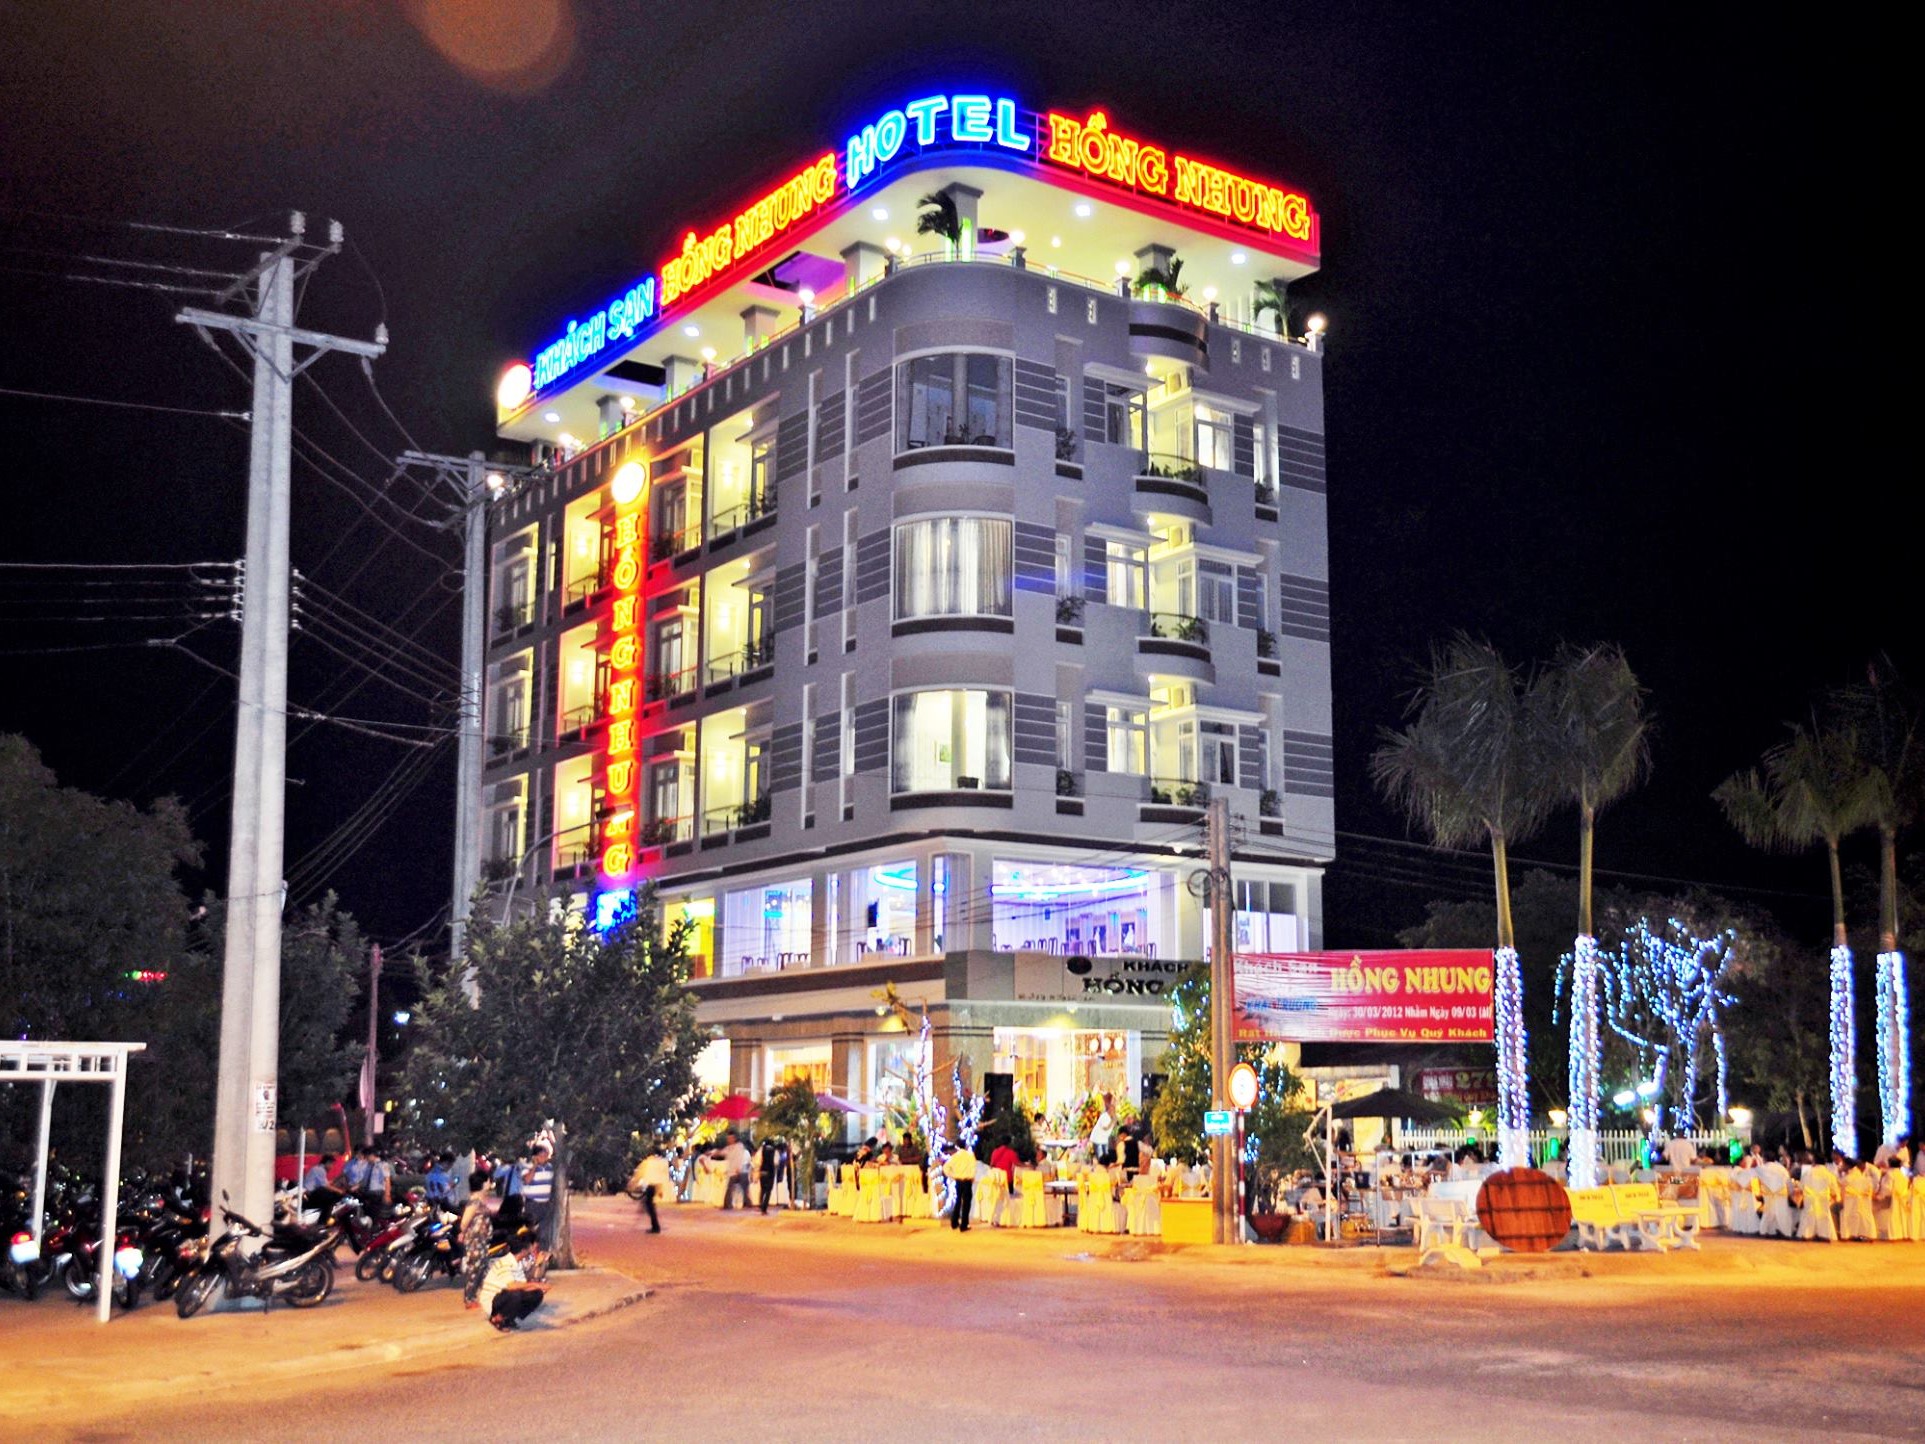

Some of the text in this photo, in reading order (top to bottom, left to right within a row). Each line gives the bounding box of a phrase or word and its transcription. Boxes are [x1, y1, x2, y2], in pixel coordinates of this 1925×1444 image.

[846, 94, 1031, 189] HOTEL
[1049, 112, 1311, 240] HỒNG NHUNG
[660, 153, 838, 306] HỒNG NHUNG
[534, 276, 655, 390] KHÁCH SẠN
[1330, 954, 1492, 994] HỒNG NHUNG
[1353, 1006, 1403, 1018] 30/03/2012
[1451, 1006, 1477, 1018] 09/03
